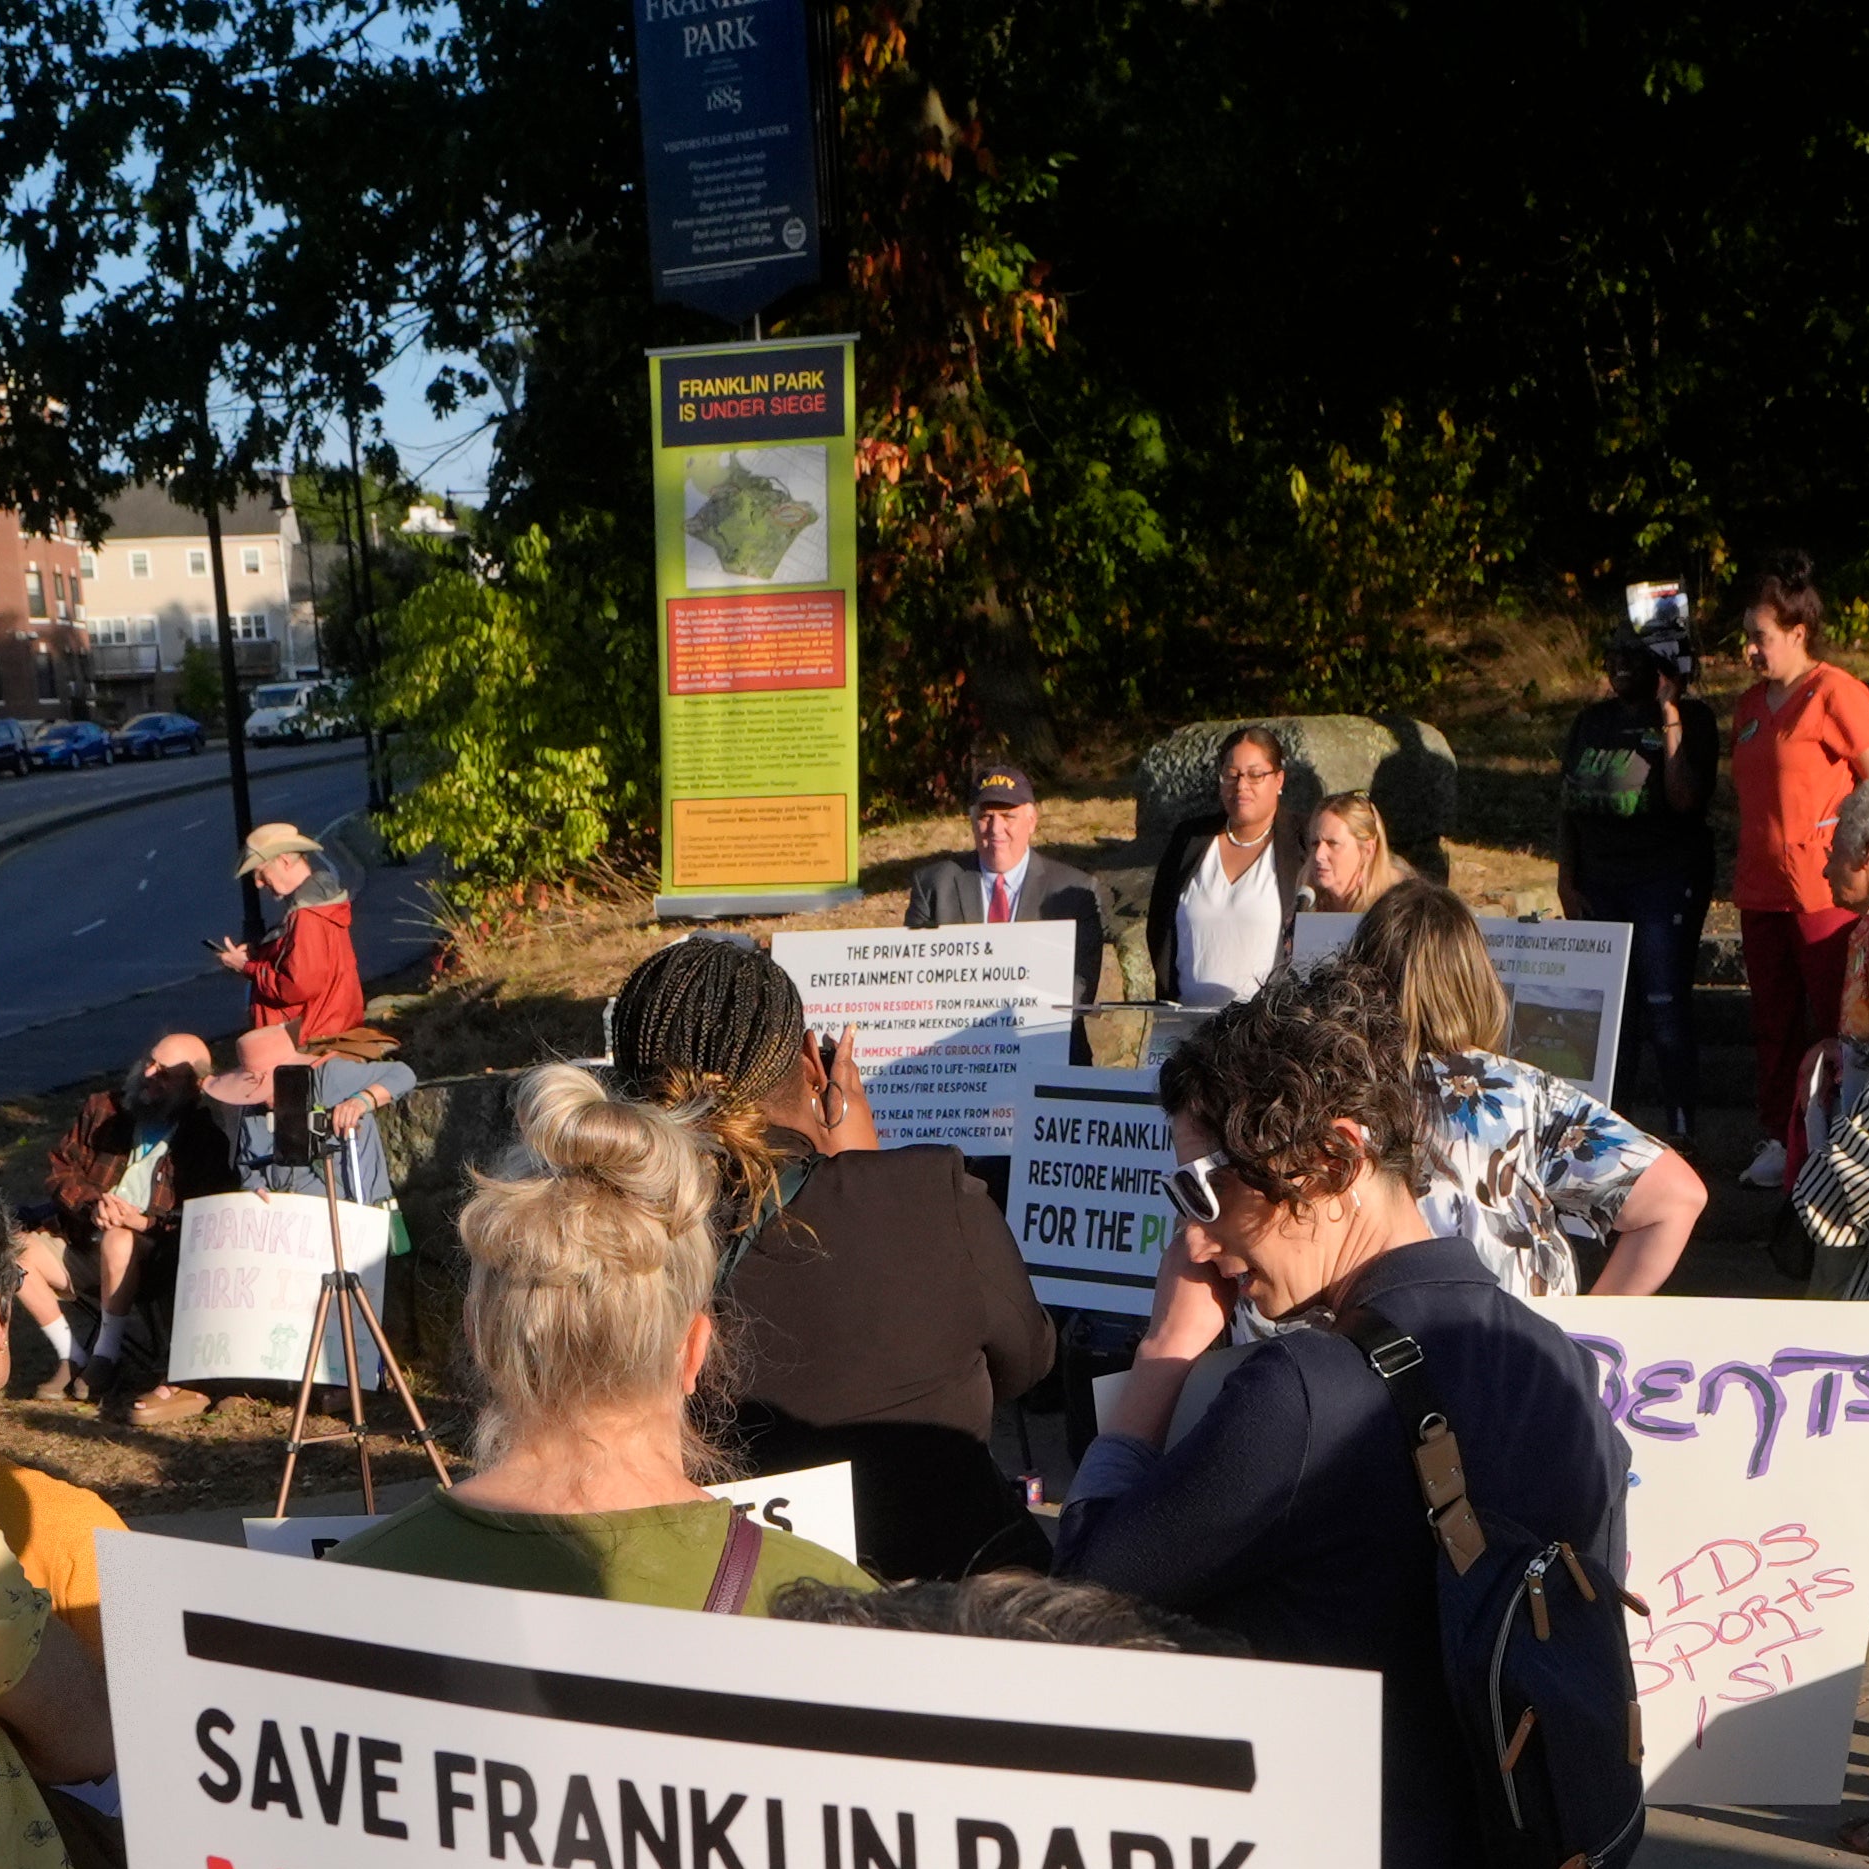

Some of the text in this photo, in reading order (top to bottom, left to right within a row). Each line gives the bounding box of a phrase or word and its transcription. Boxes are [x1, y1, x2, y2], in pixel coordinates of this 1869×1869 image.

[683, 15, 758, 58] PARK
[679, 370, 824, 399] FRANKLIN PARK
[679, 393, 826, 422] IS UNDER SIEGE
[847, 941, 994, 960] THE PRIVATE SPORTS &
[1568, 937, 1596, 953] STADIUM
[810, 966, 1030, 988] ENTERTAINMENT COMPLEX WOULD:
[844, 1001, 881, 1013] BOSTON
[883, 999, 934, 1012] RESIDENTS
[935, 998, 962, 1010] FROM
[963, 997, 1010, 1010] FRANKLIN
[1012, 996, 1039, 1009] PARK
[811, 1021, 824, 1032] ON
[843, 1018, 916, 1031] WRM-WEATHER
[919, 1017, 970, 1030] WEEKENDS
[972, 1016, 997, 1029] EACH
[999, 1015, 1026, 1027] YEAR
[861, 1046, 904, 1058] IMMENSE
[906, 1044, 942, 1057] TRAFFIC
[945, 1044, 991, 1056] GRIDLOCK
[994, 1044, 1021, 1055] FROM
[889, 1063, 929, 1076] LEADING
[931, 1063, 943, 1075] TO
[877, 1083, 889, 1095] TO
[890, 1082, 935, 1095] EMS/FIRE
[937, 1081, 988, 1094] RESPONSE
[888, 1109, 914, 1121] NEAR
[916, 1108, 933, 1120] THE
[935, 1108, 961, 1120] PARK
[963, 1107, 990, 1119] FROM
[899, 1127, 914, 1139] ON
[915, 1126, 992, 1139] GAME/CONCERT
[1034, 1115, 1082, 1144] SAVE
[1028, 1159, 1162, 1196] RESTORE WHITE
[1023, 1202, 1077, 1247] FOR
[1084, 1208, 1135, 1253] THE
[181, 1268, 259, 1312] PARK
[197, 1709, 407, 1839] SAVE
